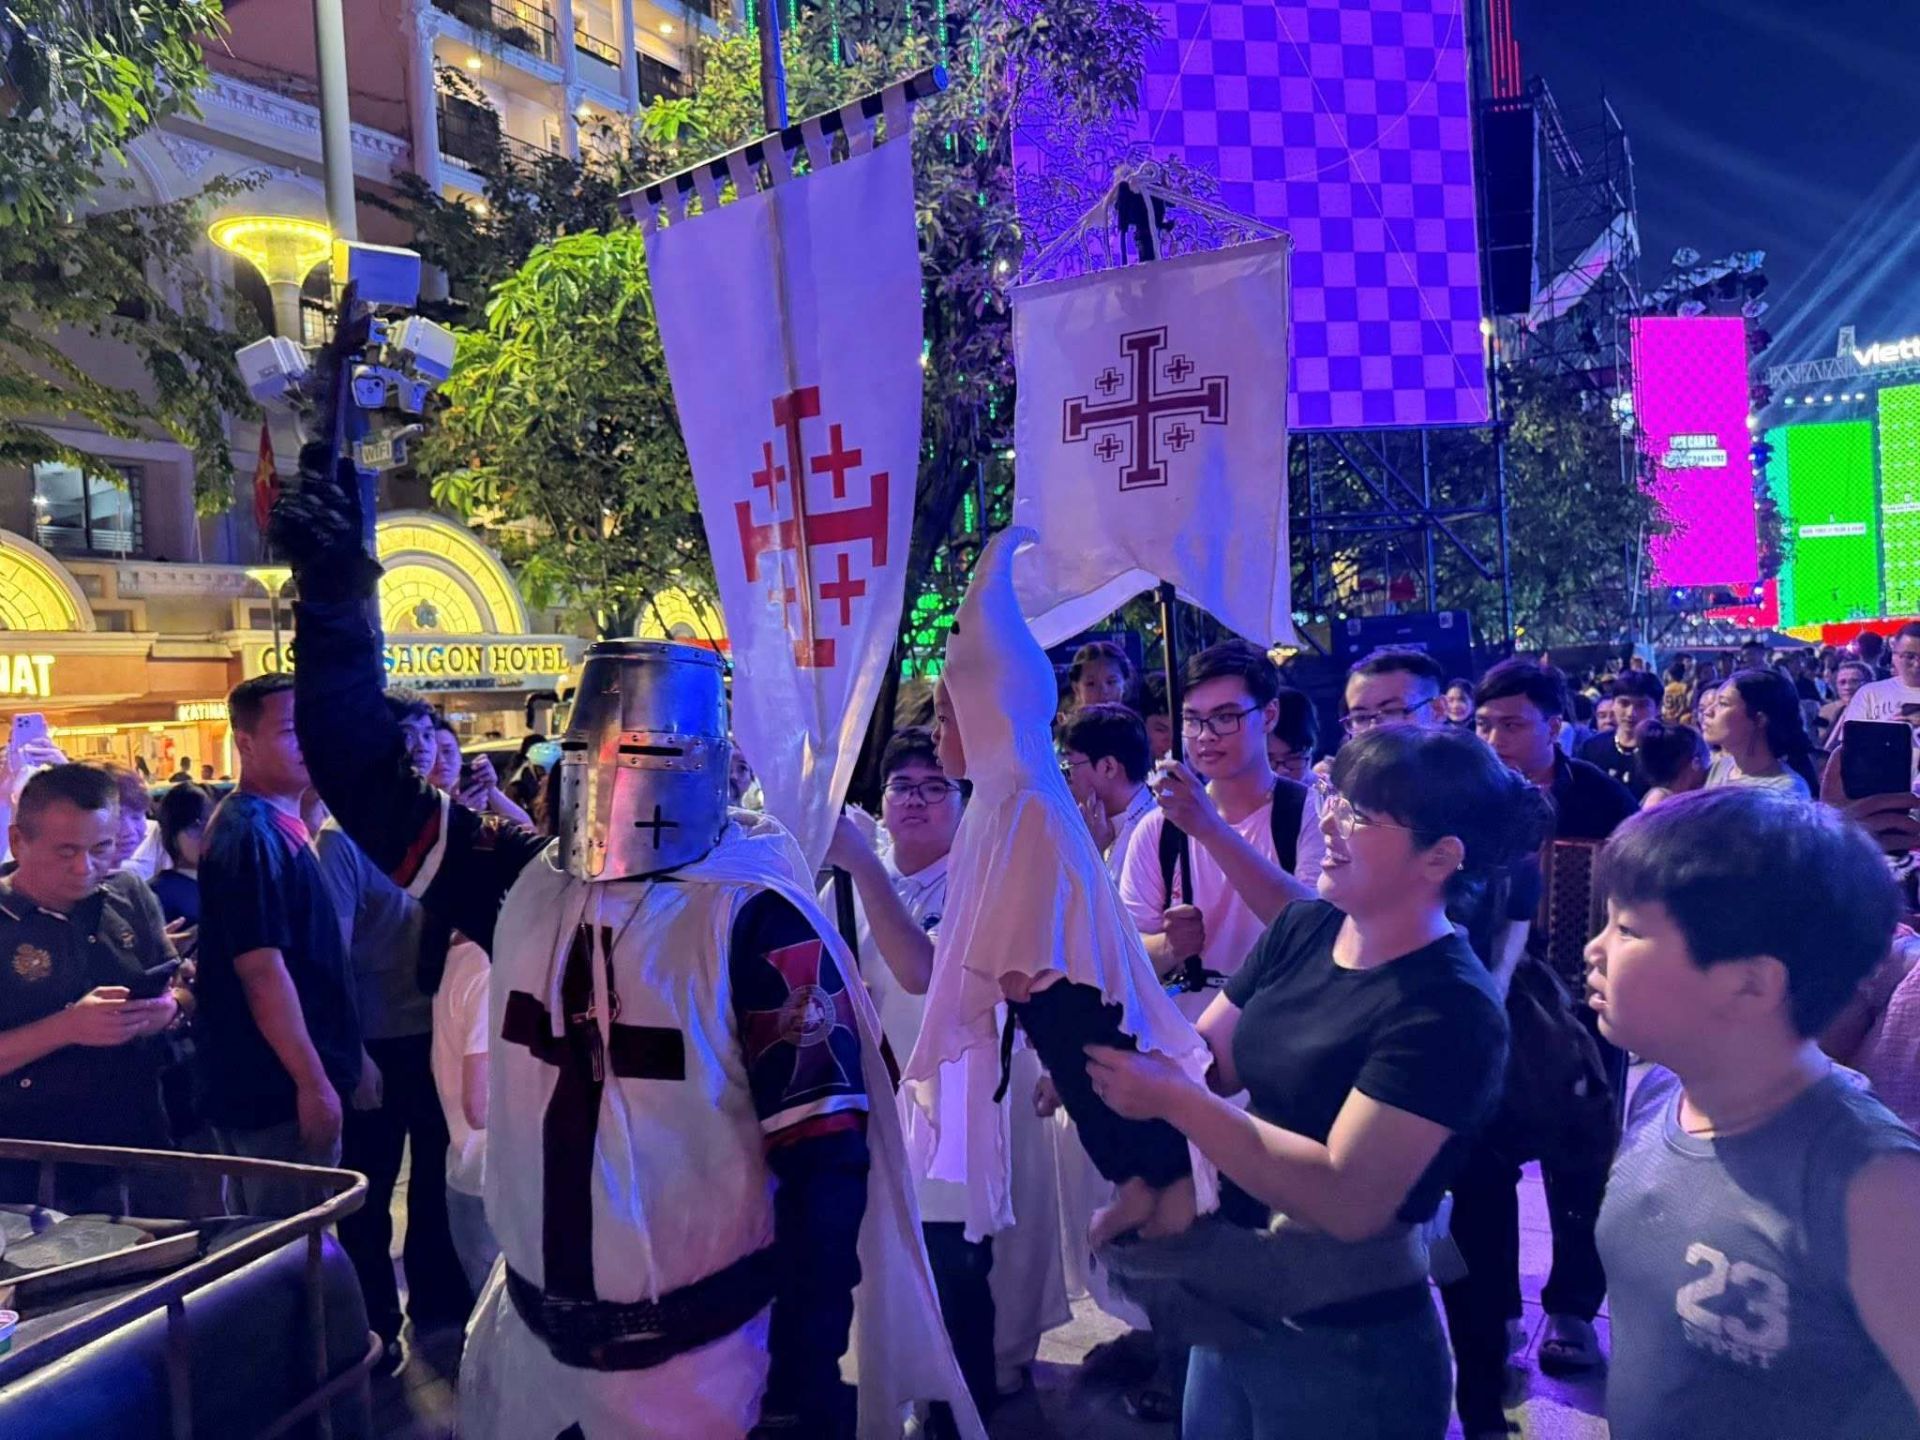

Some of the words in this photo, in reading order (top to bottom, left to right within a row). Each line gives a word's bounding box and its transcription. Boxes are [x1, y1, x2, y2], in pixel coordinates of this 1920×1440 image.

[384, 643, 483, 677] SAIGON
[488, 643, 571, 675] HOTEL
[179, 703, 229, 721] KATINA
[1676, 1242, 1790, 1350] 23
